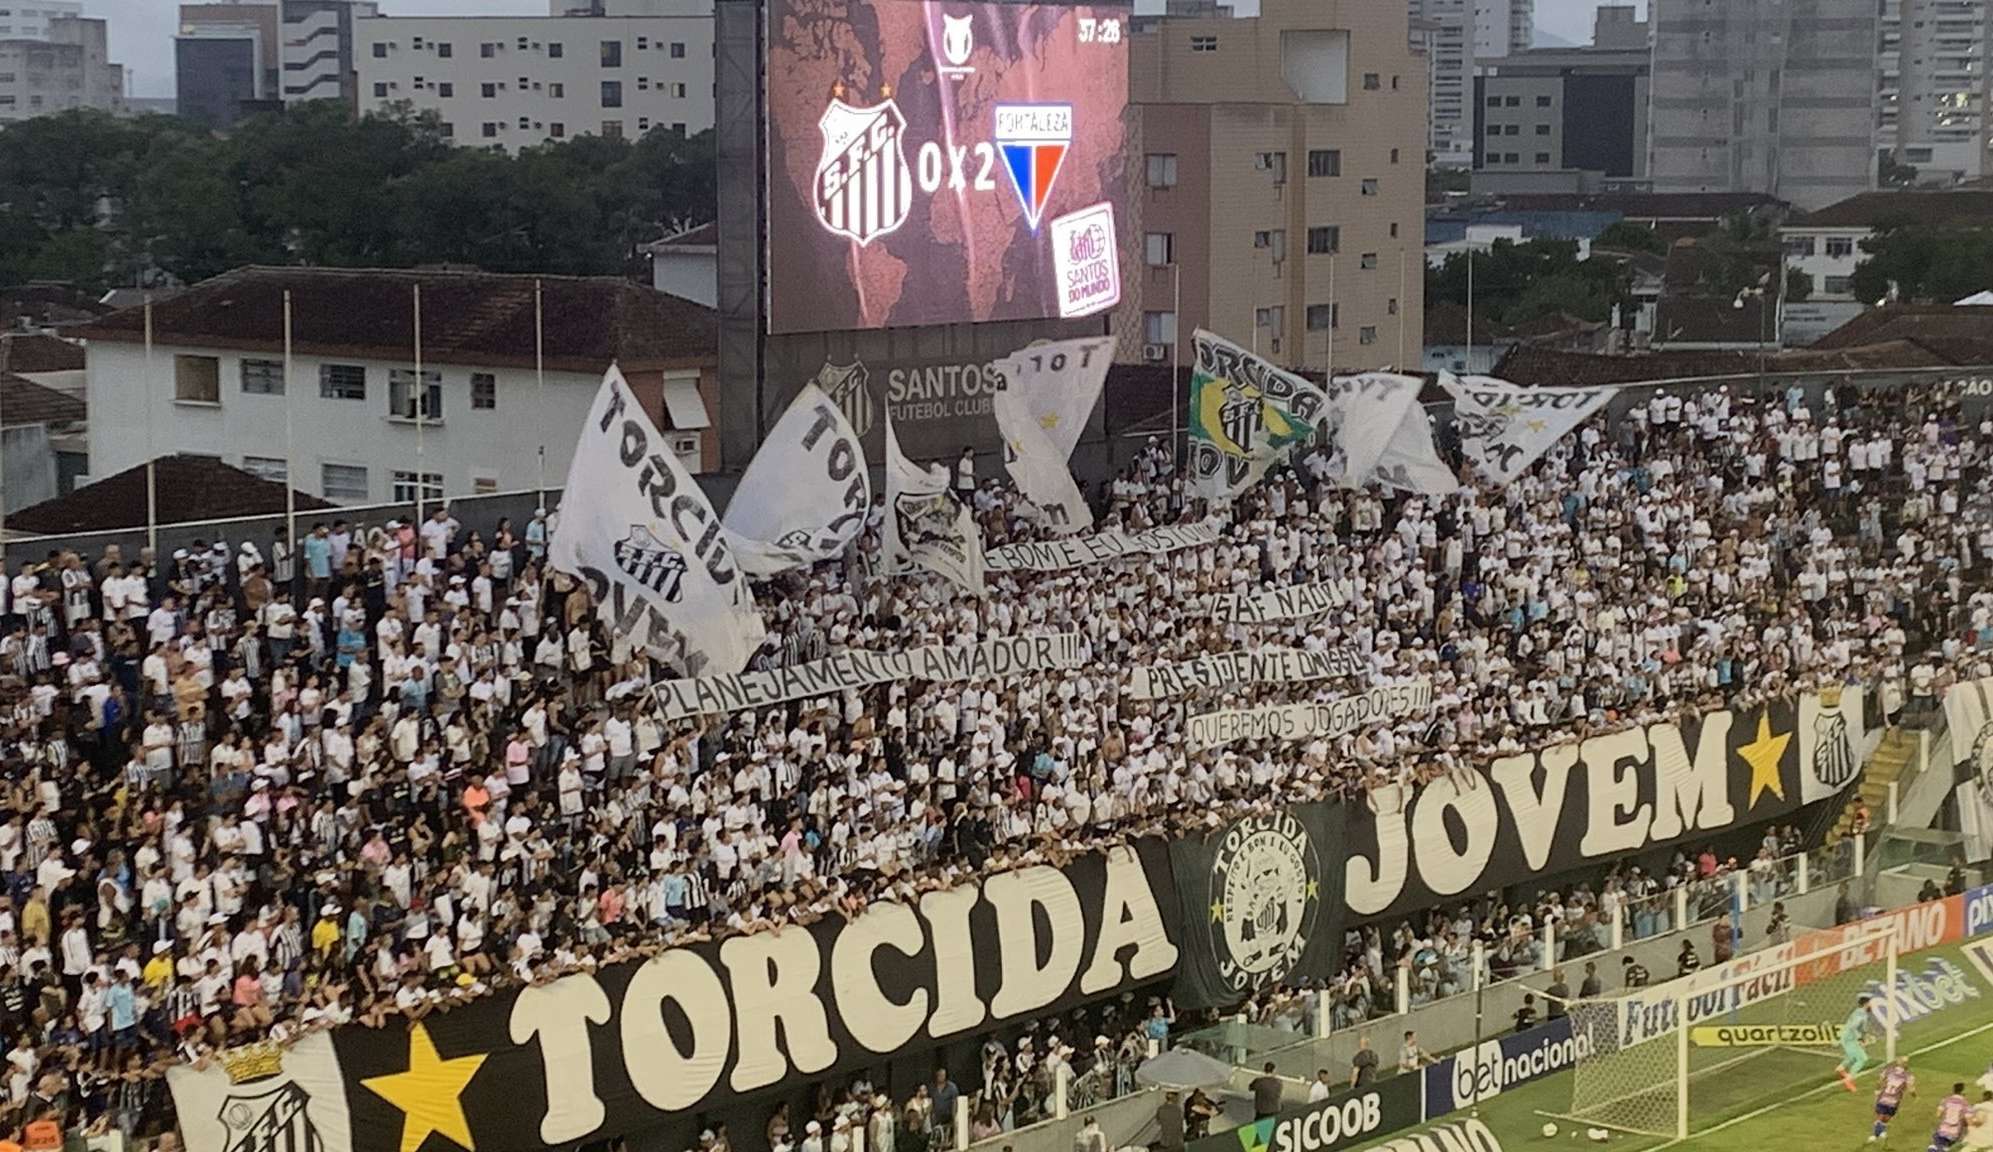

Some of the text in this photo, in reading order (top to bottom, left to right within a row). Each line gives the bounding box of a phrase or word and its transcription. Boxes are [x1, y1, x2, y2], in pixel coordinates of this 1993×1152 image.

[998, 112, 1069, 133] FORTALEZA
[918, 141, 942, 193] 0
[974, 141, 996, 191] 2
[1067, 260, 1109, 288] SANTOS
[1068, 278, 1110, 303] DO MUNDO
[888, 362, 997, 401] SANTOS
[889, 397, 996, 420] FUTEBOL CLUB
[654, 650, 914, 720] PLANEJAMENTO
[1191, 709, 1295, 746] QUEREMOS
[1344, 709, 1734, 915] JOVEM
[1212, 811, 1308, 875] TORCIDA
[1838, 902, 1948, 972] BETANO
[1967, 888, 1993, 937] pi
[1219, 933, 1307, 991] JOVEM
[509, 843, 1179, 1145] TORCIDA
[1717, 1024, 1842, 1045] quartzolit
[1457, 1022, 1596, 1100] bet nacional
[1275, 1091, 1381, 1152] SICOOB
